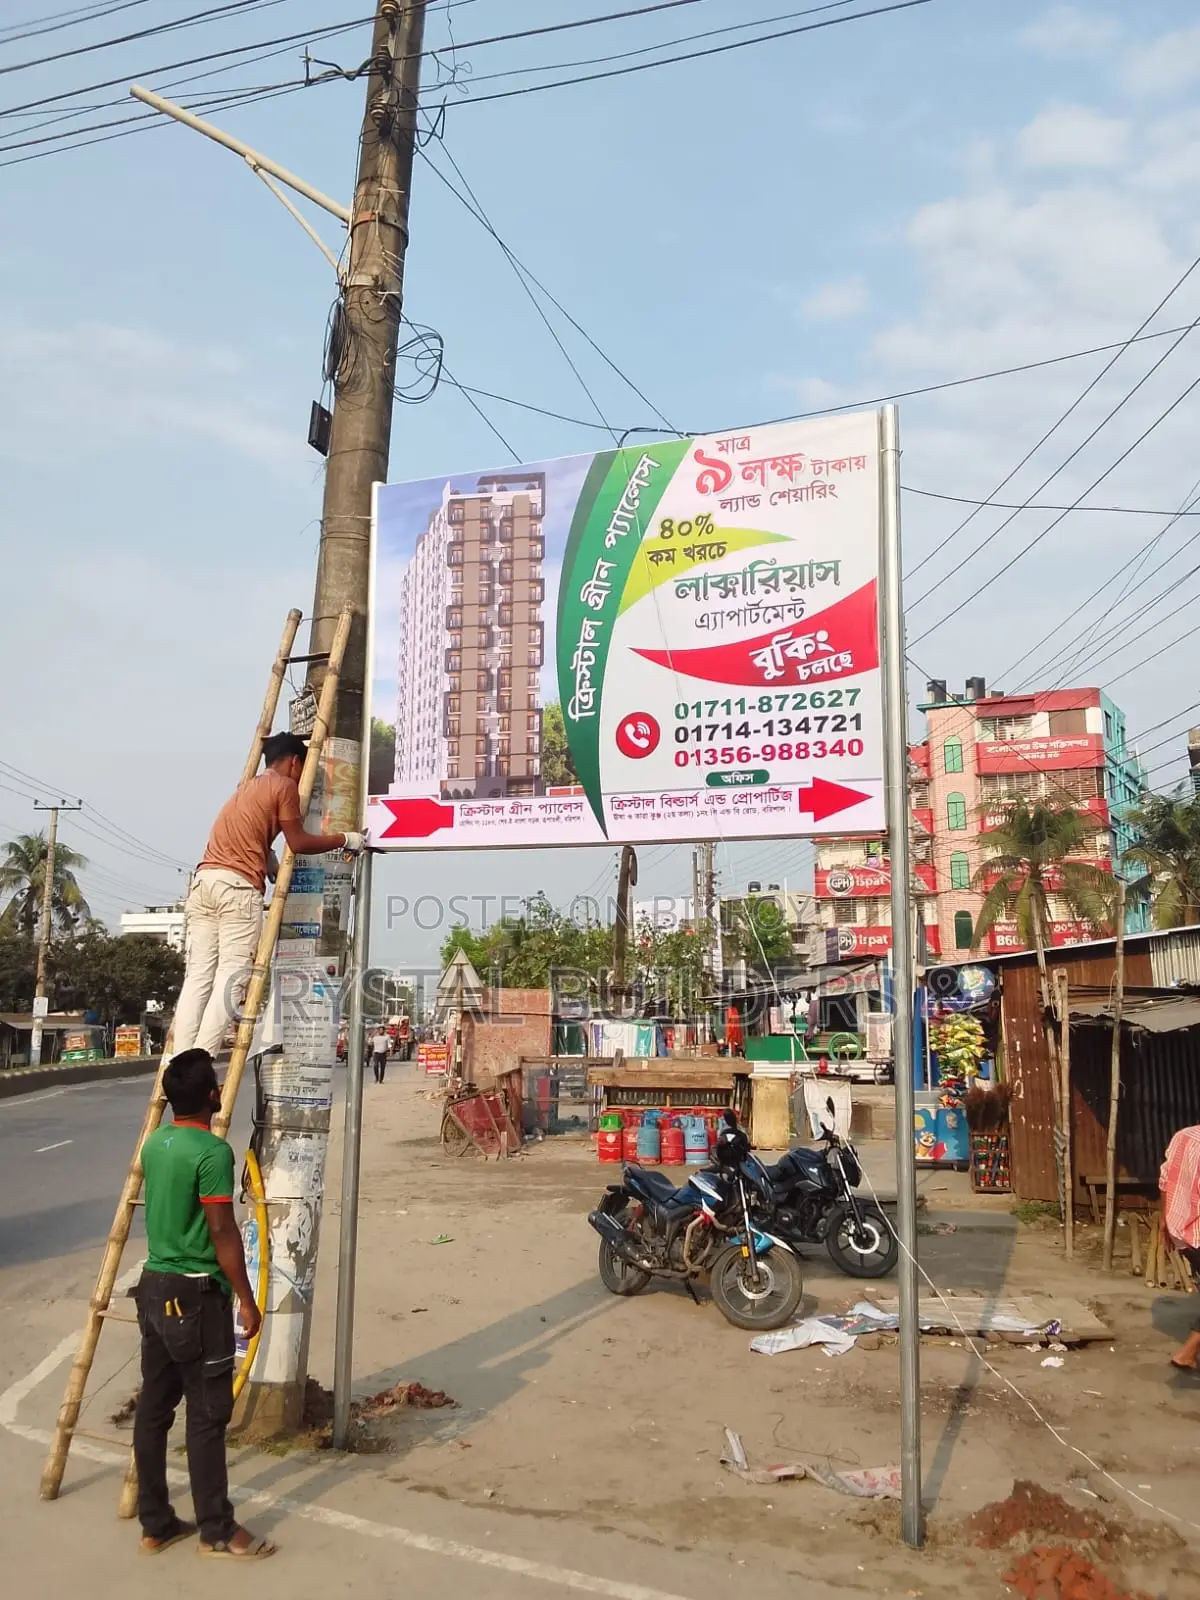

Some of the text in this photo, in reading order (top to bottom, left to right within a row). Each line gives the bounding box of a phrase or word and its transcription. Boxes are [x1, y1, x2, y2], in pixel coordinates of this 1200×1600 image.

[716, 436, 751, 454] মাত্র
[694, 449, 867, 494] ৯ লক্ষ টাকায়
[718, 480, 838, 512] ল্যান্ড শেয়ারিং
[580, 556, 618, 611] গ্রীন
[604, 453, 662, 550] প্যালেস
[660, 513, 714, 540] ৪০%
[647, 541, 727, 567] কম খরচে
[674, 558, 842, 602] লাক্সারিয়াস
[749, 629, 835, 680] বুকিং
[796, 650, 854, 681] চলছে
[674, 688, 862, 720] 01711-872627
[674, 713, 863, 743] 01714-134721
[674, 738, 864, 767] 01356-988340
[720, 771, 754, 784] অফিস
[509, 801, 532, 815] গ্রীন
[537, 802, 583, 815] প্যালেস
[732, 787, 793, 805] প্রোপার্টিজ
